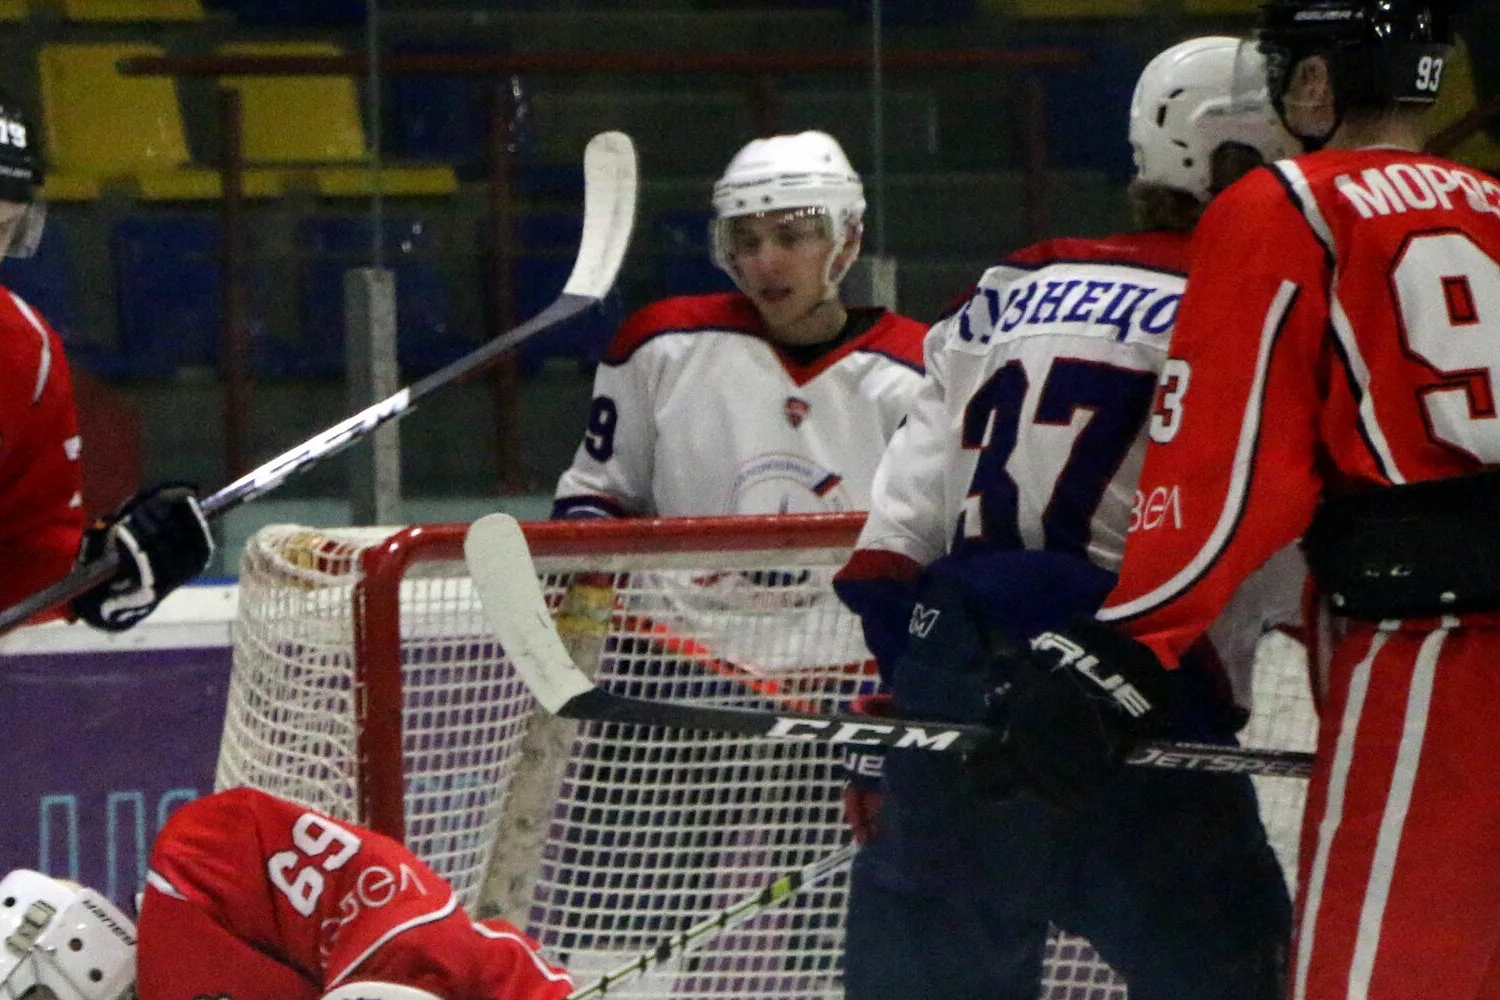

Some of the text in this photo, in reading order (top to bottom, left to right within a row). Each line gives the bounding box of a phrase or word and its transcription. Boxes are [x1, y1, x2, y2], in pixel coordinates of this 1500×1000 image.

[1416, 56, 1443, 92] 93
[1388, 227, 1500, 466] 9
[949, 357, 1156, 556] 37
[766, 717, 961, 751] CCM
[268, 812, 361, 917] 69
